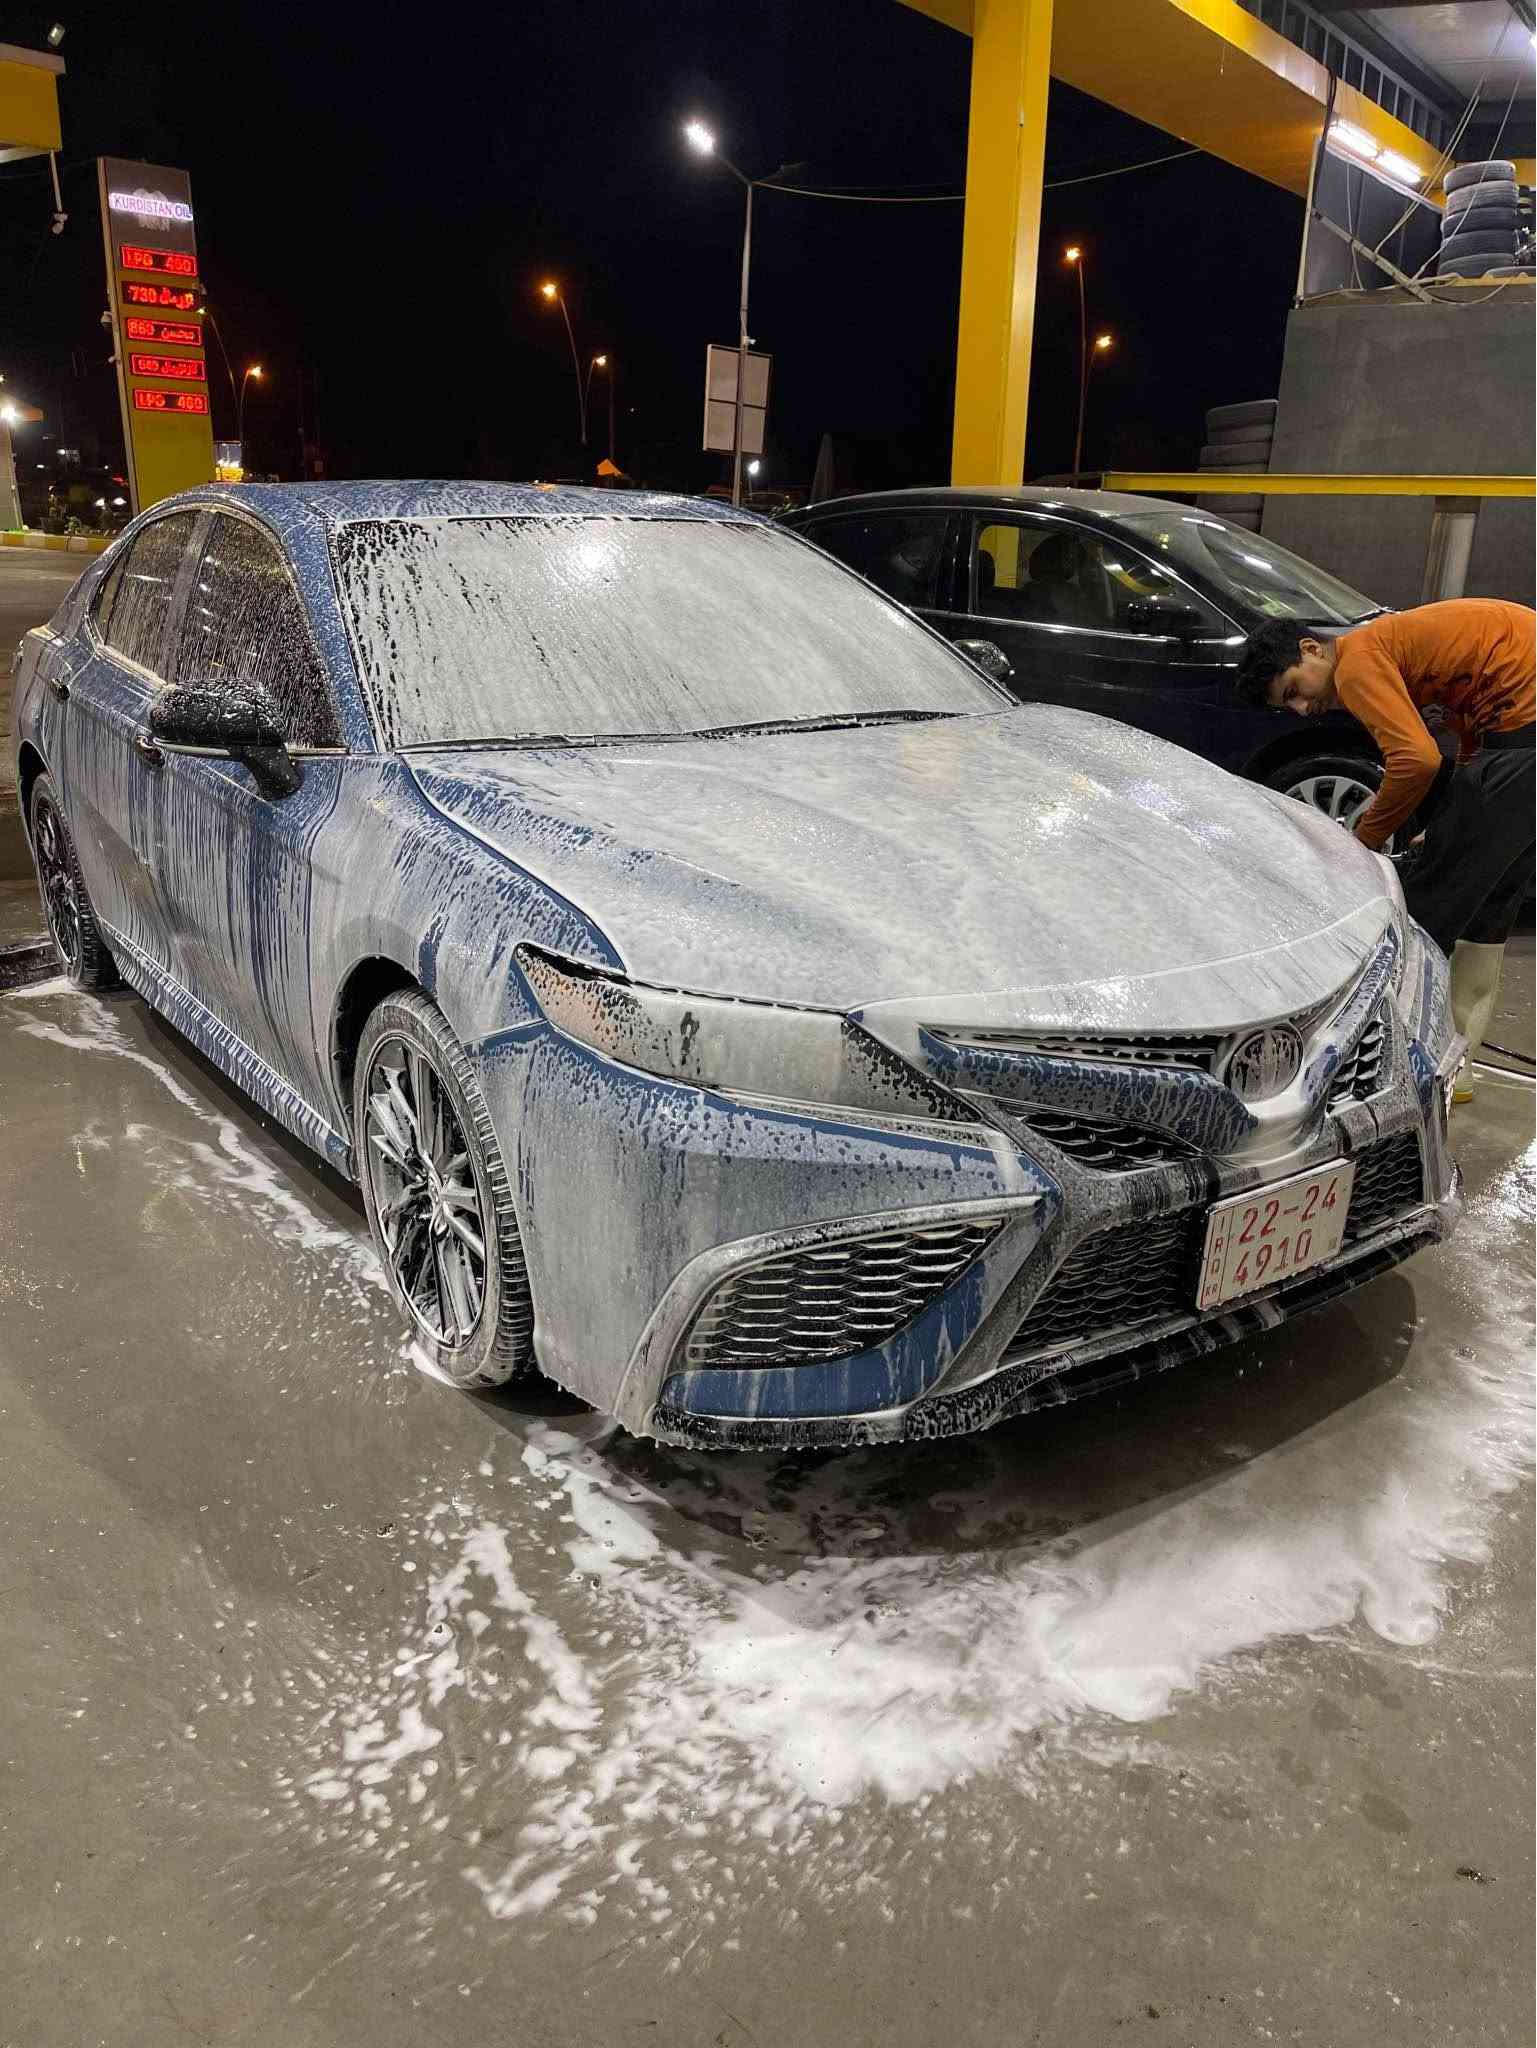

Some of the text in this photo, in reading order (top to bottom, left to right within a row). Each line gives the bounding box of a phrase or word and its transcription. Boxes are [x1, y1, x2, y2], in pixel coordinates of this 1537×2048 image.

[113, 194, 193, 218] KURDISTAN OIL
[1238, 1176, 1339, 1245] 22-24
[1232, 1228, 1313, 1286] 4910
